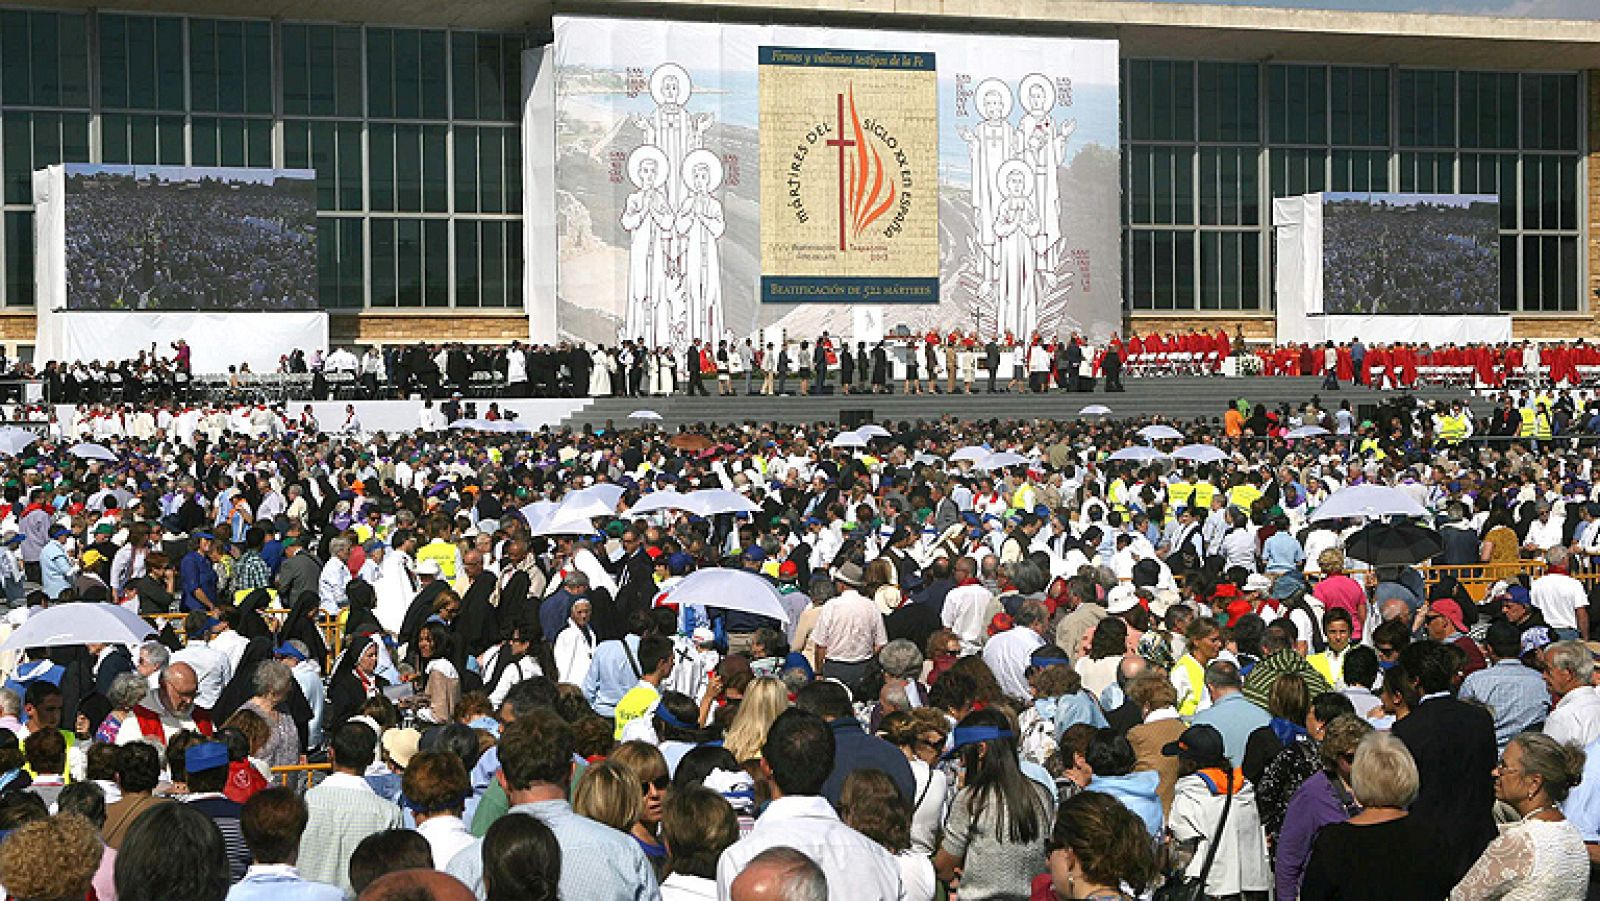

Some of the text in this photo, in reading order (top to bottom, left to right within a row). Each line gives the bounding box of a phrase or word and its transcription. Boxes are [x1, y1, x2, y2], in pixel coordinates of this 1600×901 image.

[772, 50, 802, 62] Firmes
[804, 54, 811, 65] y
[814, 51, 852, 64] valientes
[856, 53, 888, 68] testigos
[889, 54, 900, 66] de
[902, 55, 911, 66] la
[806, 122, 832, 144] DEL
[863, 285, 882, 299] 522
